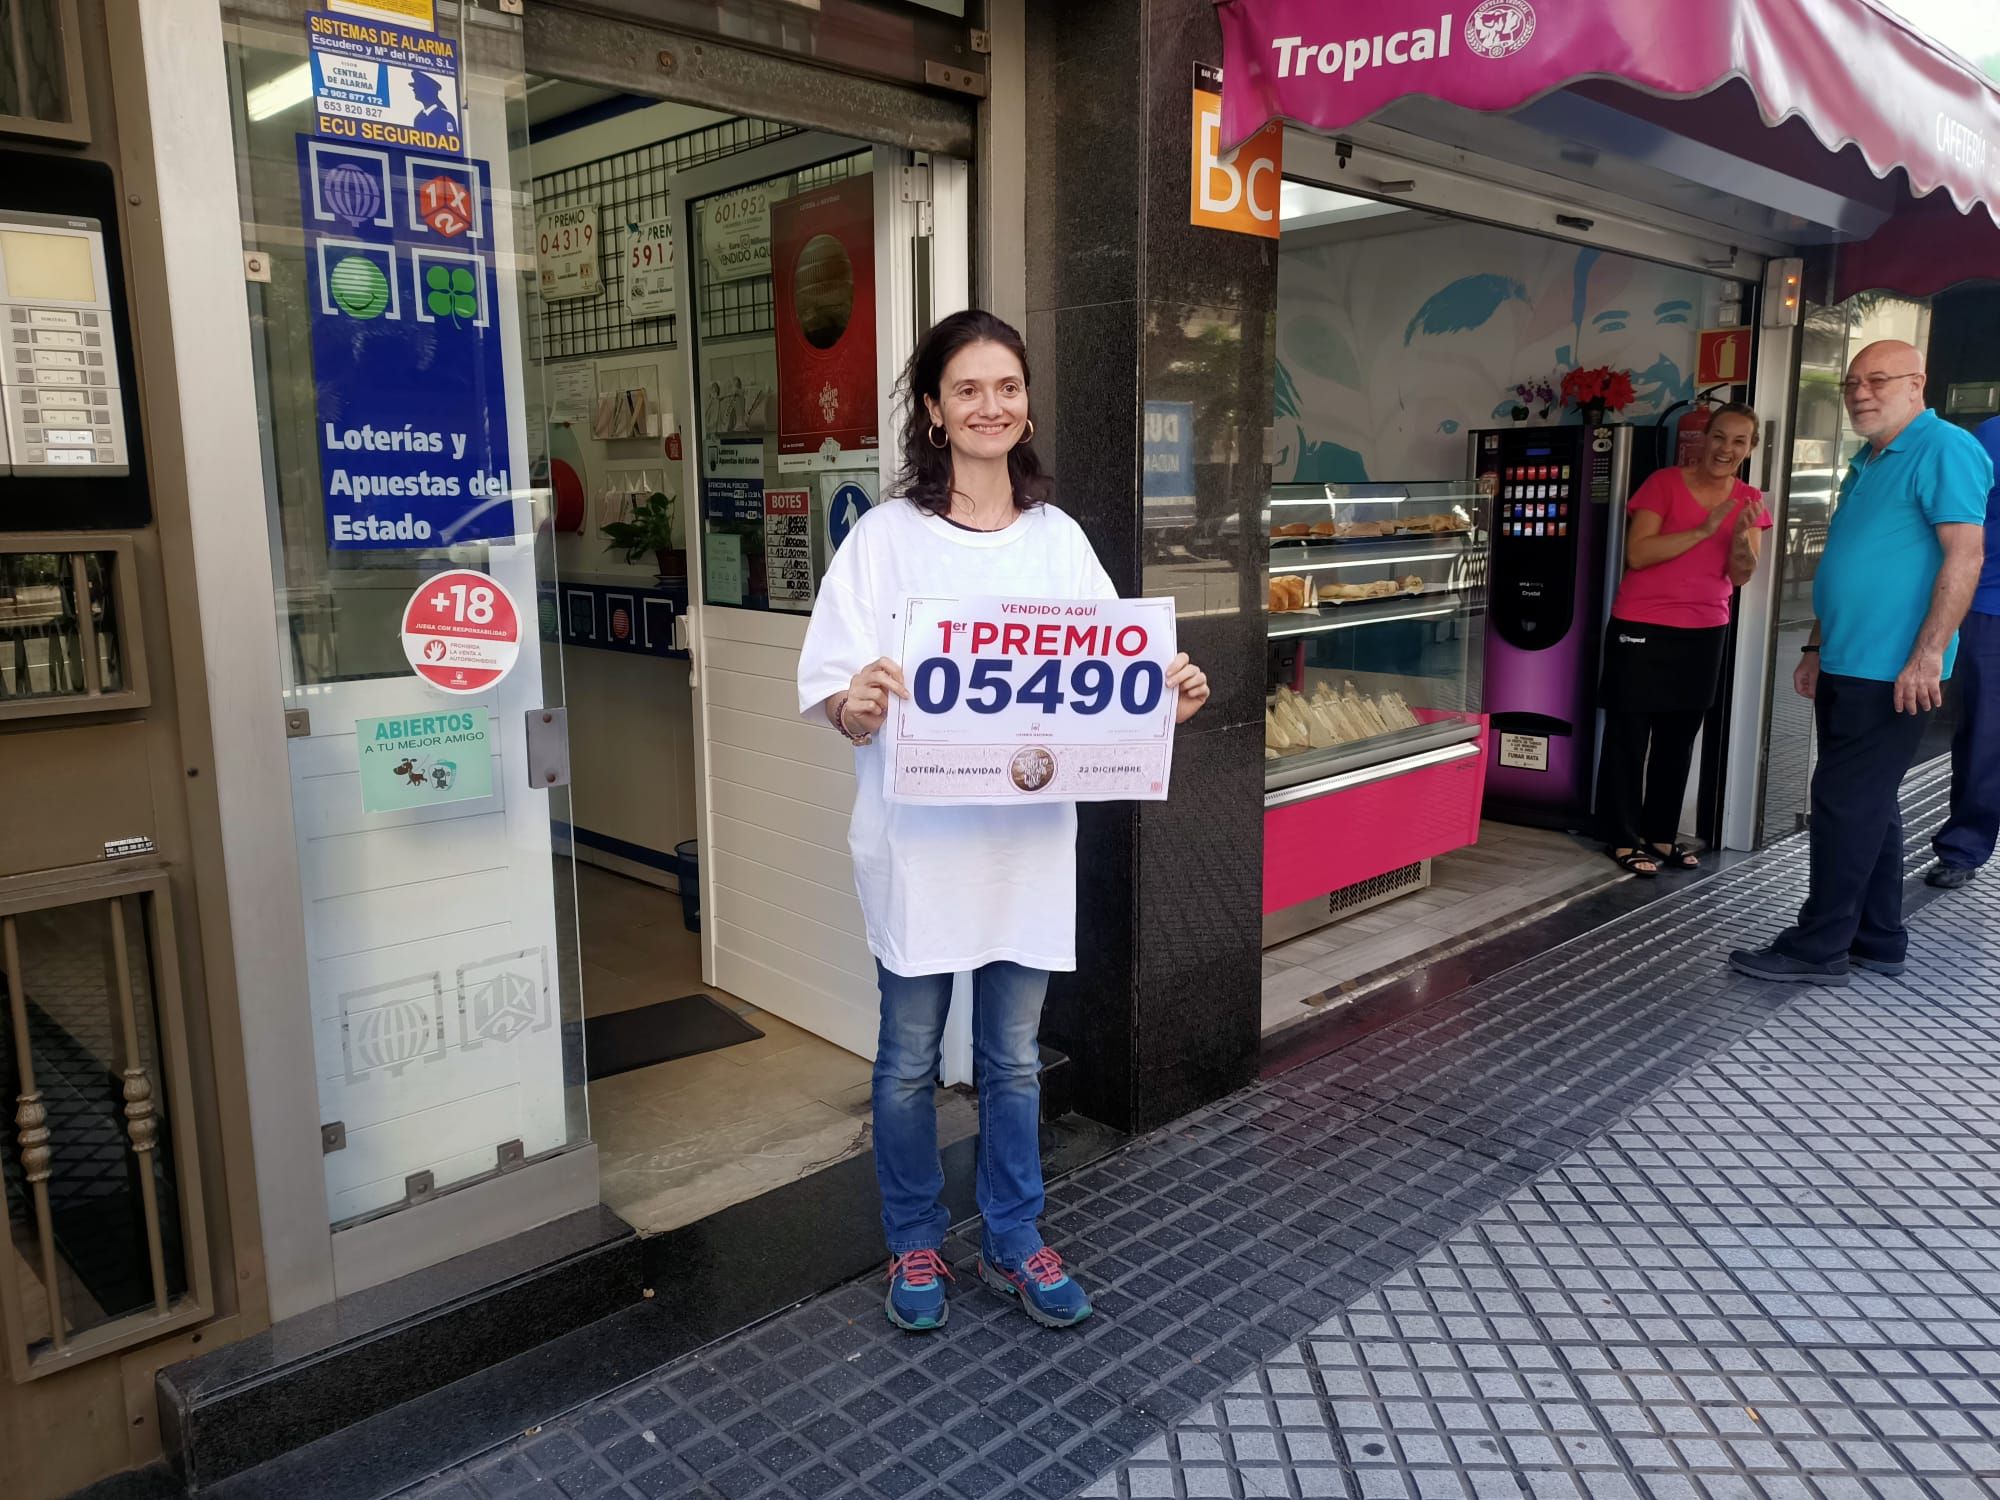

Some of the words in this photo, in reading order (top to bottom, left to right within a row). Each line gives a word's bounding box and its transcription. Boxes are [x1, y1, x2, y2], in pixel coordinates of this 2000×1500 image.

[310, 16, 377, 43] SISTEMAS
[381, 31, 398, 47] DE
[401, 35, 454, 58] ALARMA
[1272, 14, 1452, 82] Tropical
[312, 34, 362, 52] Escudero
[366, 46, 372, 55] y
[390, 49, 405, 60] del
[408, 54, 434, 66] Pino,
[327, 75, 338, 84] DE
[339, 78, 374, 91] ALARMA
[332, 67, 367, 80] CENTRAL
[1201, 69, 1211, 79] BAR
[330, 89, 347, 99] 902
[367, 96, 383, 105] 172
[323, 101, 342, 112] 653
[344, 104, 362, 115] 820
[365, 108, 383, 118] 827
[319, 116, 356, 137] ECU
[361, 122, 461, 152] SEGURIDAD
[554, 209, 585, 229] PREMIO
[541, 224, 592, 254] 04319
[718, 249, 751, 265] VENDIDO
[325, 423, 443, 452] Loterías
[450, 433, 467, 460] y
[330, 469, 460, 503] Apuestas
[468, 470, 508, 496] del
[772, 495, 802, 509] BOTES
[333, 513, 431, 541] Estado
[431, 584, 494, 624] +18
[1001, 603, 1061, 616] VENDIDO
[1065, 603, 1098, 617] AQUÍ
[452, 626, 507, 637] RESPONSABILIDAD
[970, 622, 1149, 657] PREMIO
[913, 657, 1164, 715] 05490
[375, 713, 474, 741] ABIERTOS
[364, 745, 374, 754] A
[377, 743, 394, 752] TU
[398, 737, 442, 750] MEJOR
[445, 731, 485, 744] AMIGO
[905, 764, 946, 775] LOTERÍA
[957, 766, 1002, 775] NAVIDAD
[1092, 765, 1142, 774] DICIEMBRE
